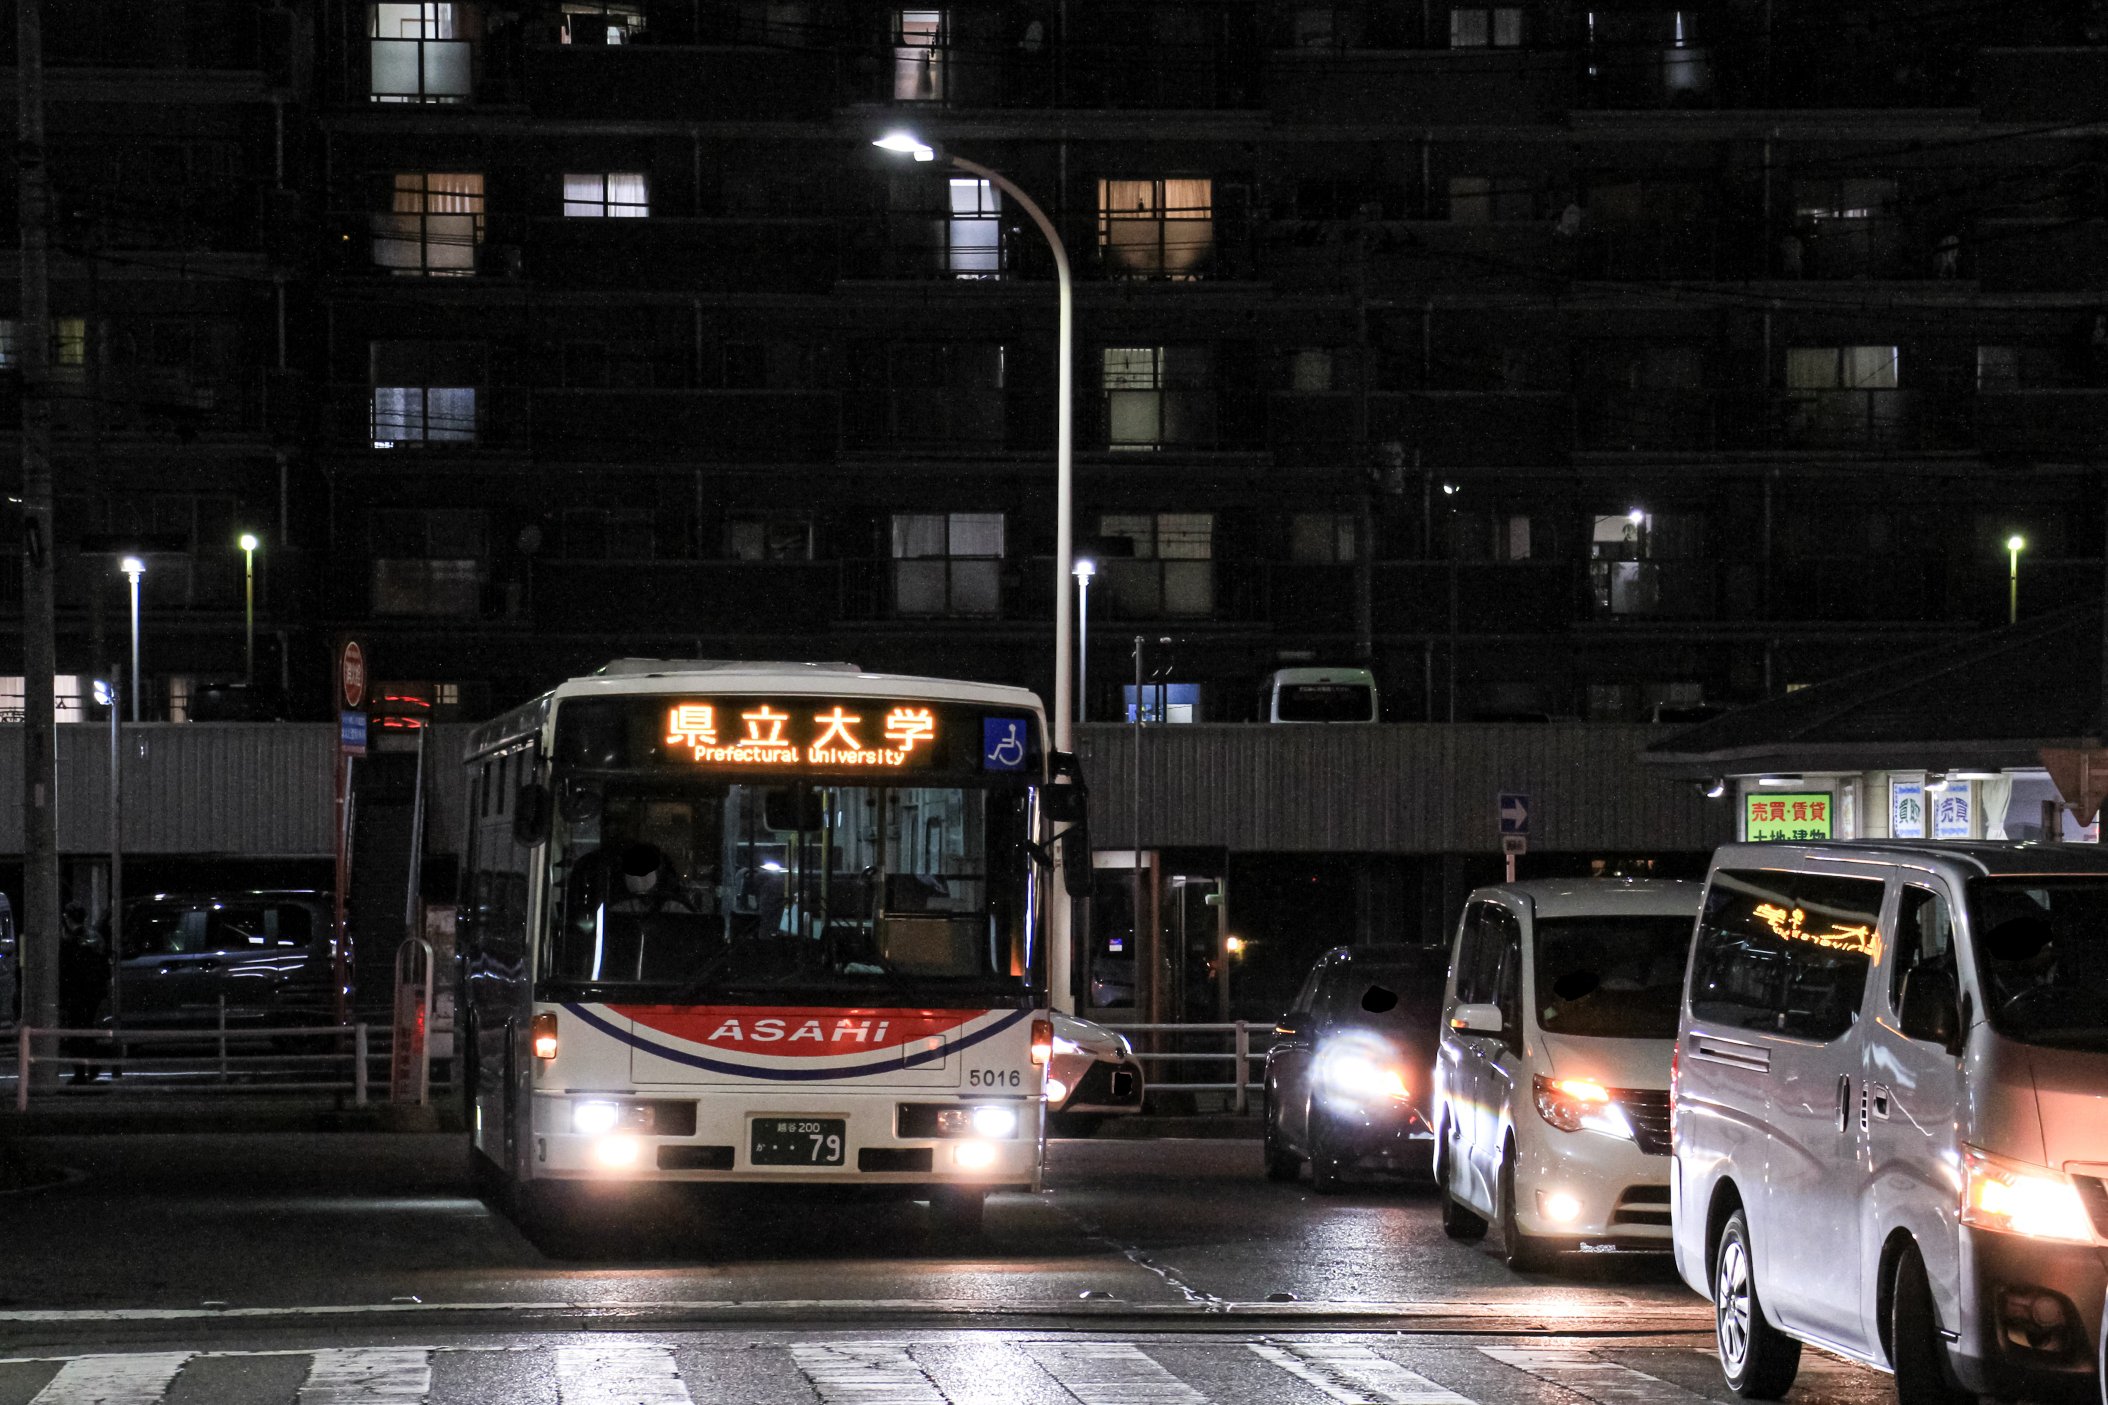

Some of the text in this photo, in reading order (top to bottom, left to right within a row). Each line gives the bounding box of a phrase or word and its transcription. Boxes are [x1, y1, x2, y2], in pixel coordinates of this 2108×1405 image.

[666, 705, 934, 752] 県立大学
[694, 746, 905, 765] Prefectural University
[1940, 797, 1968, 823] 売買
[969, 1070, 1020, 1087] 5016
